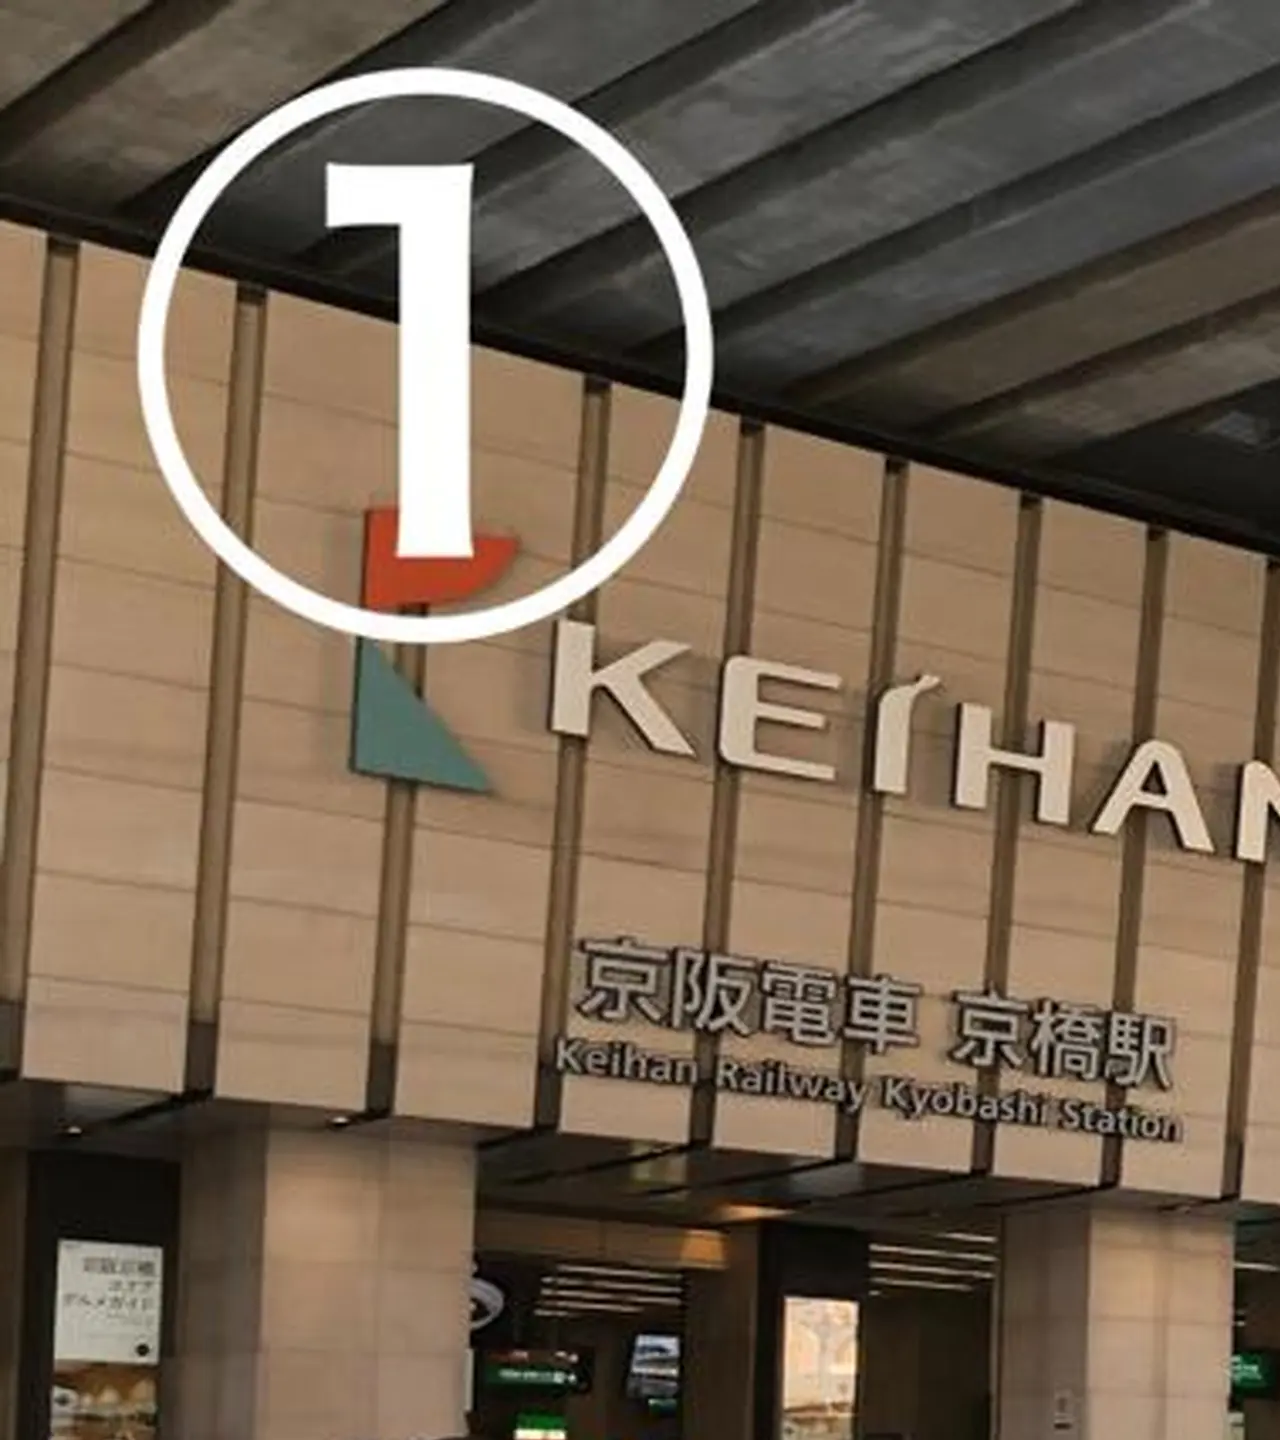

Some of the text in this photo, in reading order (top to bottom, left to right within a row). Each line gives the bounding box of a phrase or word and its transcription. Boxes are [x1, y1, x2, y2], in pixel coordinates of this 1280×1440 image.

[571, 934, 1180, 1092] 京阪電車 京橋駅
[554, 1037, 1185, 1143] Keihan Railway Kyobashi Station
